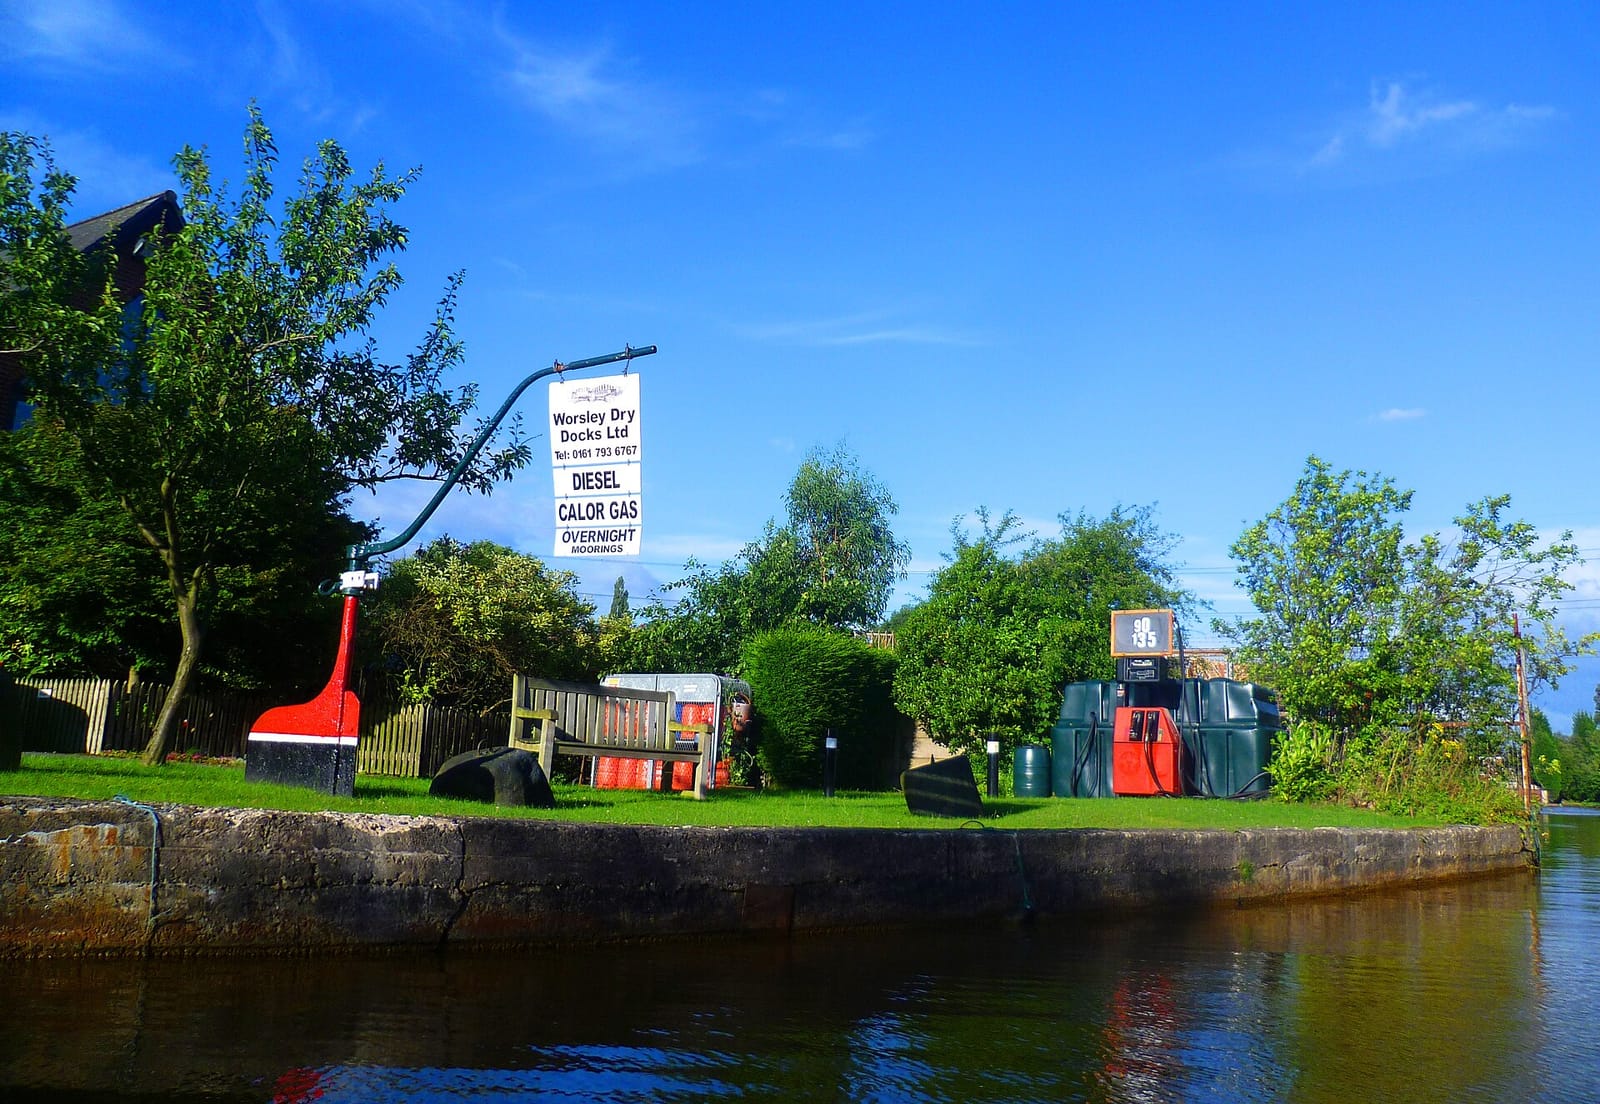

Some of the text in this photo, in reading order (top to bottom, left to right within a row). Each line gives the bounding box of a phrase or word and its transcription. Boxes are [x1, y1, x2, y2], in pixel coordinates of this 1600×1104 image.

[553, 408, 635, 426] Worsley Dry
[560, 425, 628, 443] Docks Ltd
[554, 445, 637, 460] Tel: 0161 793 6767
[572, 470, 621, 491] DIESEL
[558, 500, 638, 522] CALOR GAS
[562, 528, 636, 543] OVERNIGHT
[571, 544, 623, 554] MOORINGS
